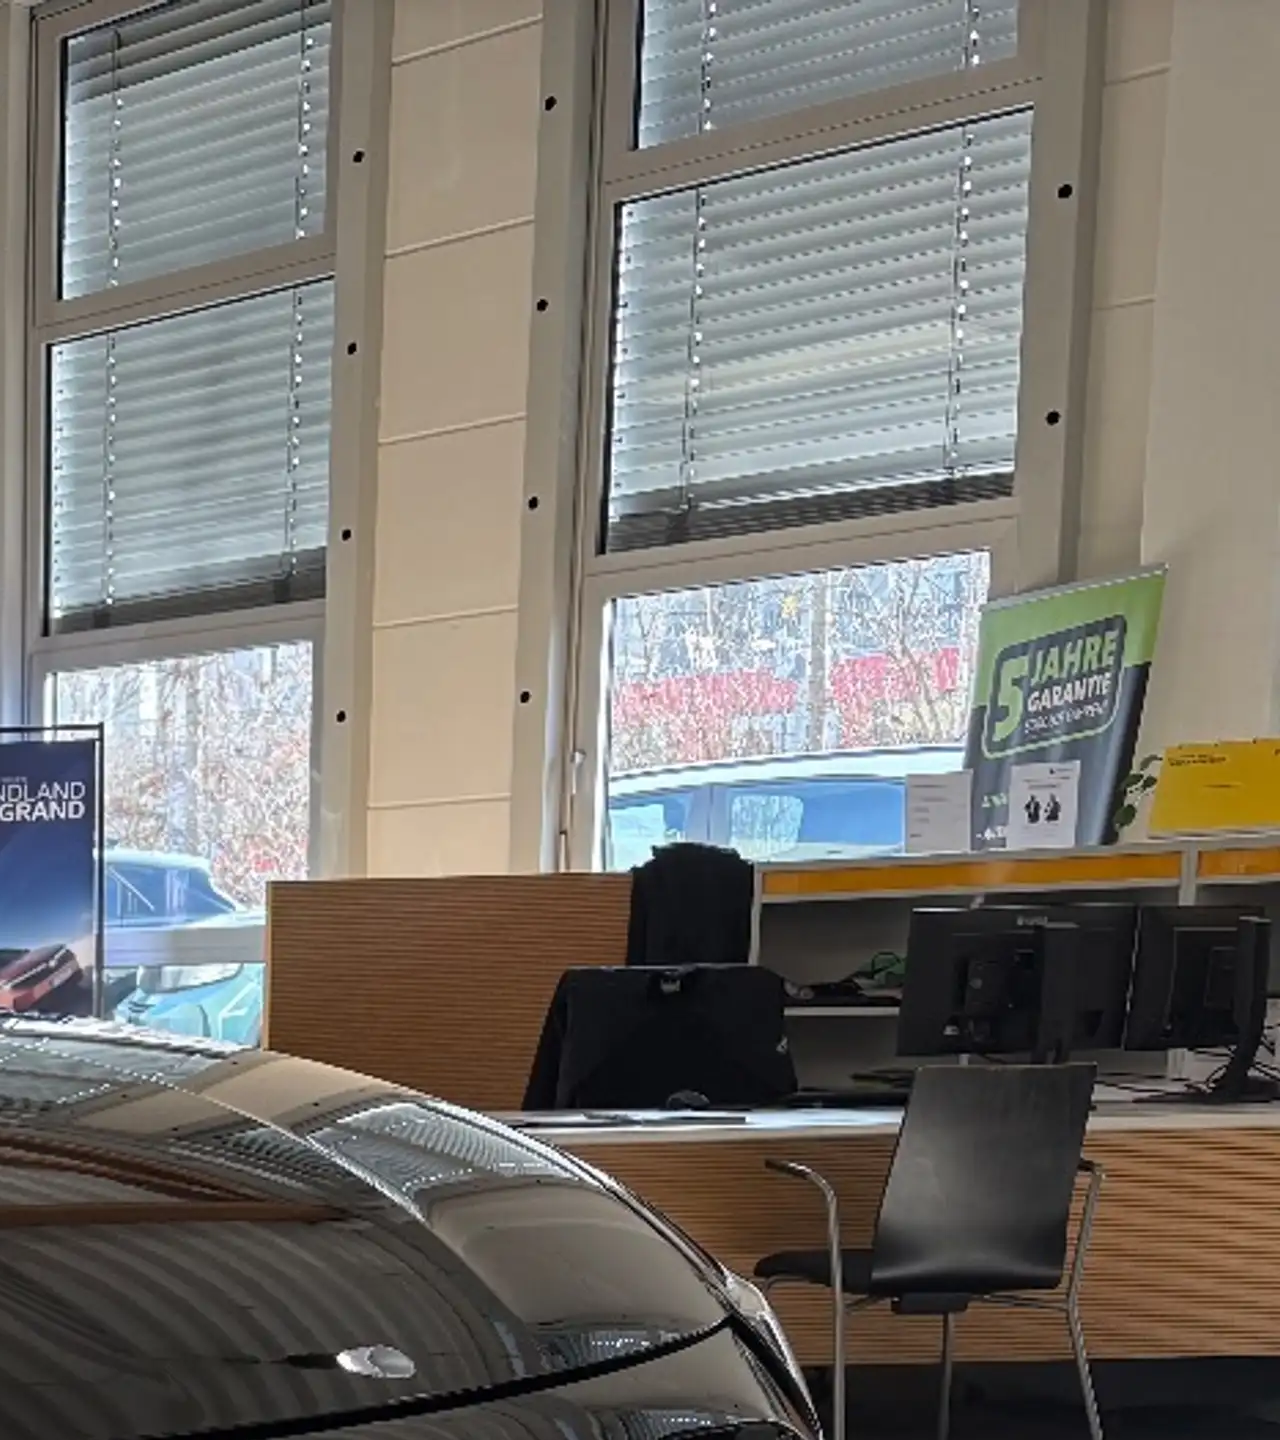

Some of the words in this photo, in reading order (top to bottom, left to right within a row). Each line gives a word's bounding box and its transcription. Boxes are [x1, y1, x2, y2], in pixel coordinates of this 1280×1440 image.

[992, 655, 1029, 742] 5
[1030, 629, 1119, 686] JAHRE
[1027, 672, 1112, 712] GARANTIE
